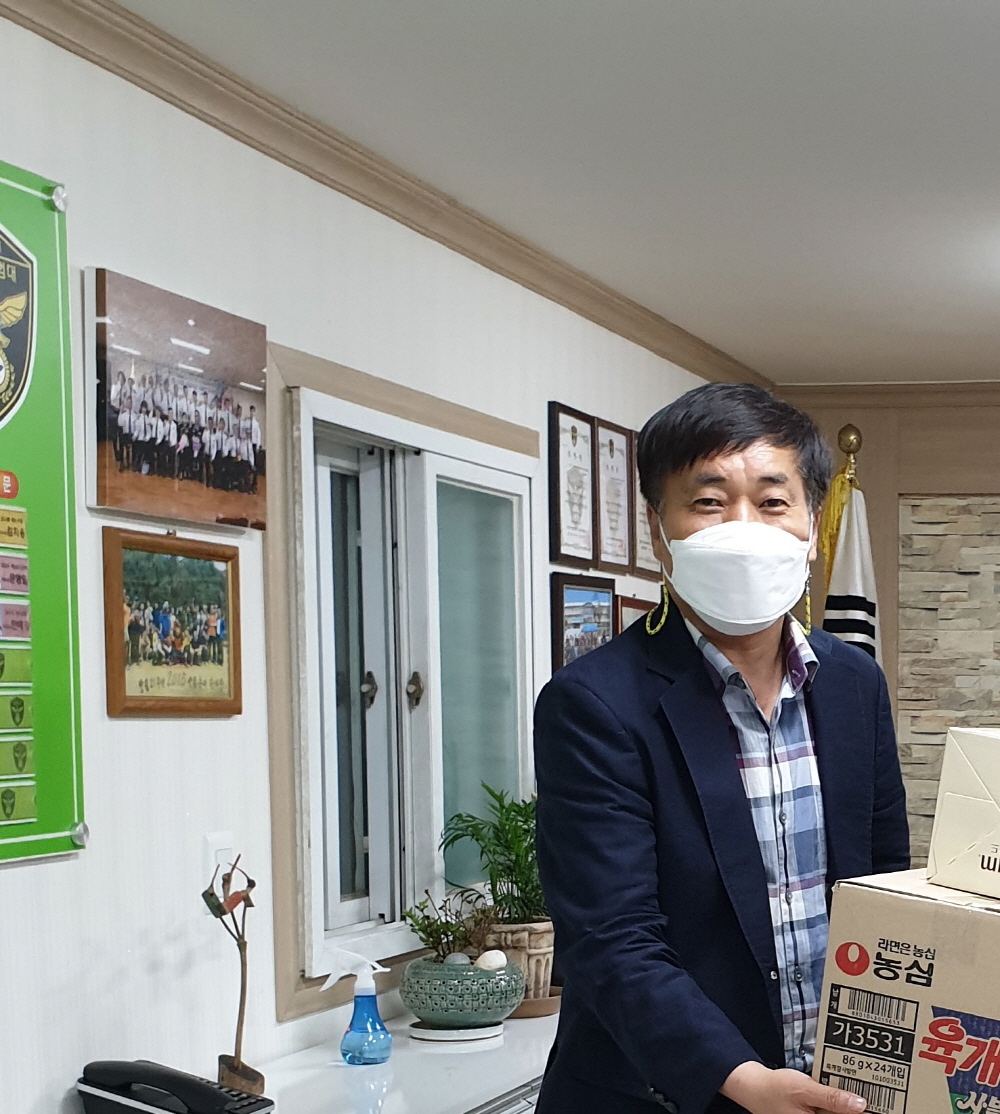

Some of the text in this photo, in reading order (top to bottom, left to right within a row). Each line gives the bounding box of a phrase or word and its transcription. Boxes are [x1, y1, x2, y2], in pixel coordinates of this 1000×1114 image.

[877, 937, 936, 961] 라면은 농심
[873, 951, 935, 988] 농심
[832, 1021, 906, 1056] 가3531
[842, 1054, 856, 1067] 86
